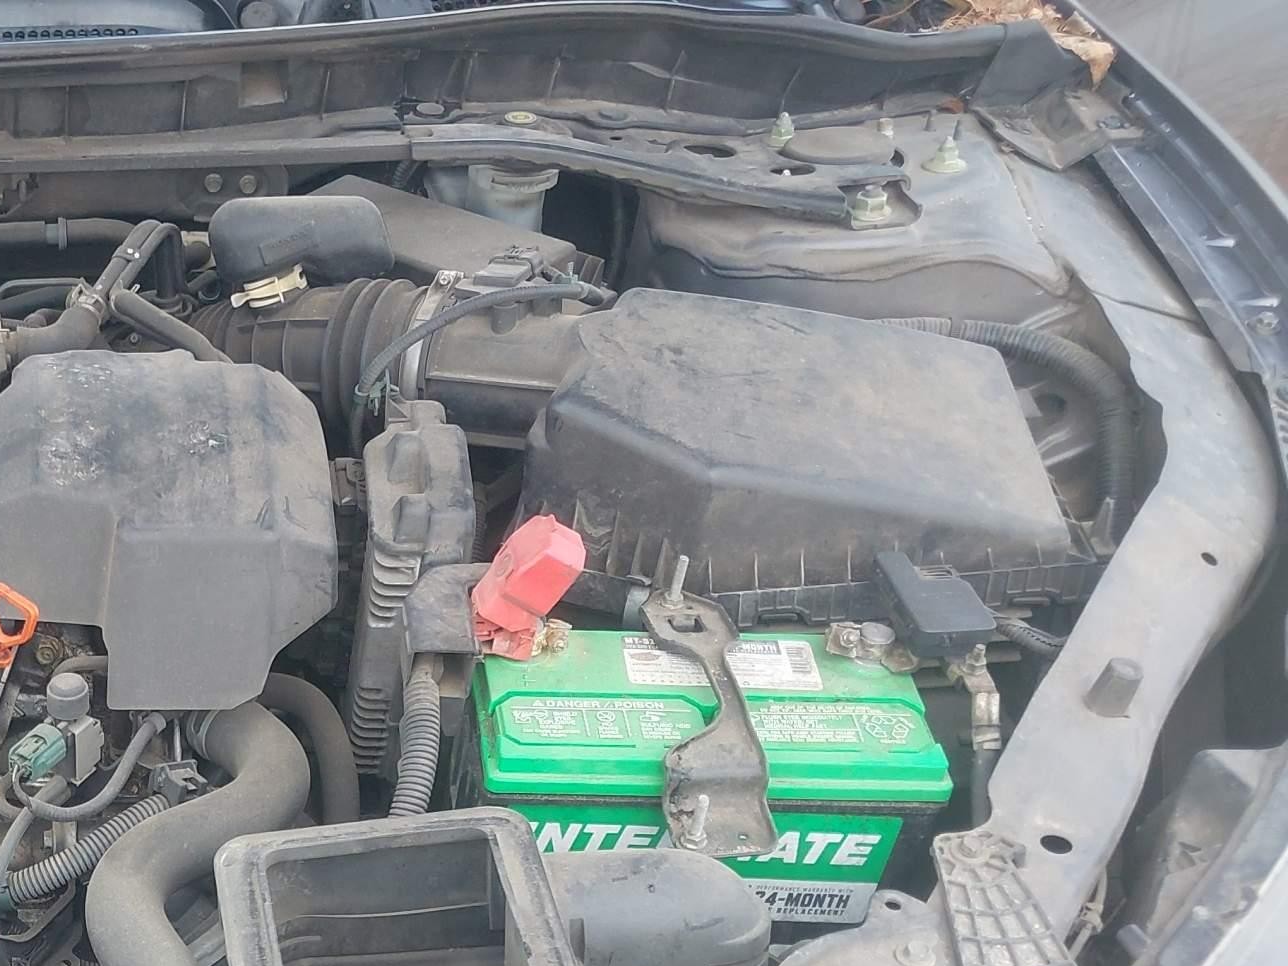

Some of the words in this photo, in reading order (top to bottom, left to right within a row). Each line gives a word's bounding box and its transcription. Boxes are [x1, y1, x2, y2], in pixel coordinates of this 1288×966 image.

[546, 700, 599, 709] DANGER
[615, 701, 664, 709] POISON
[776, 907, 845, 916] REPLACEMENT
